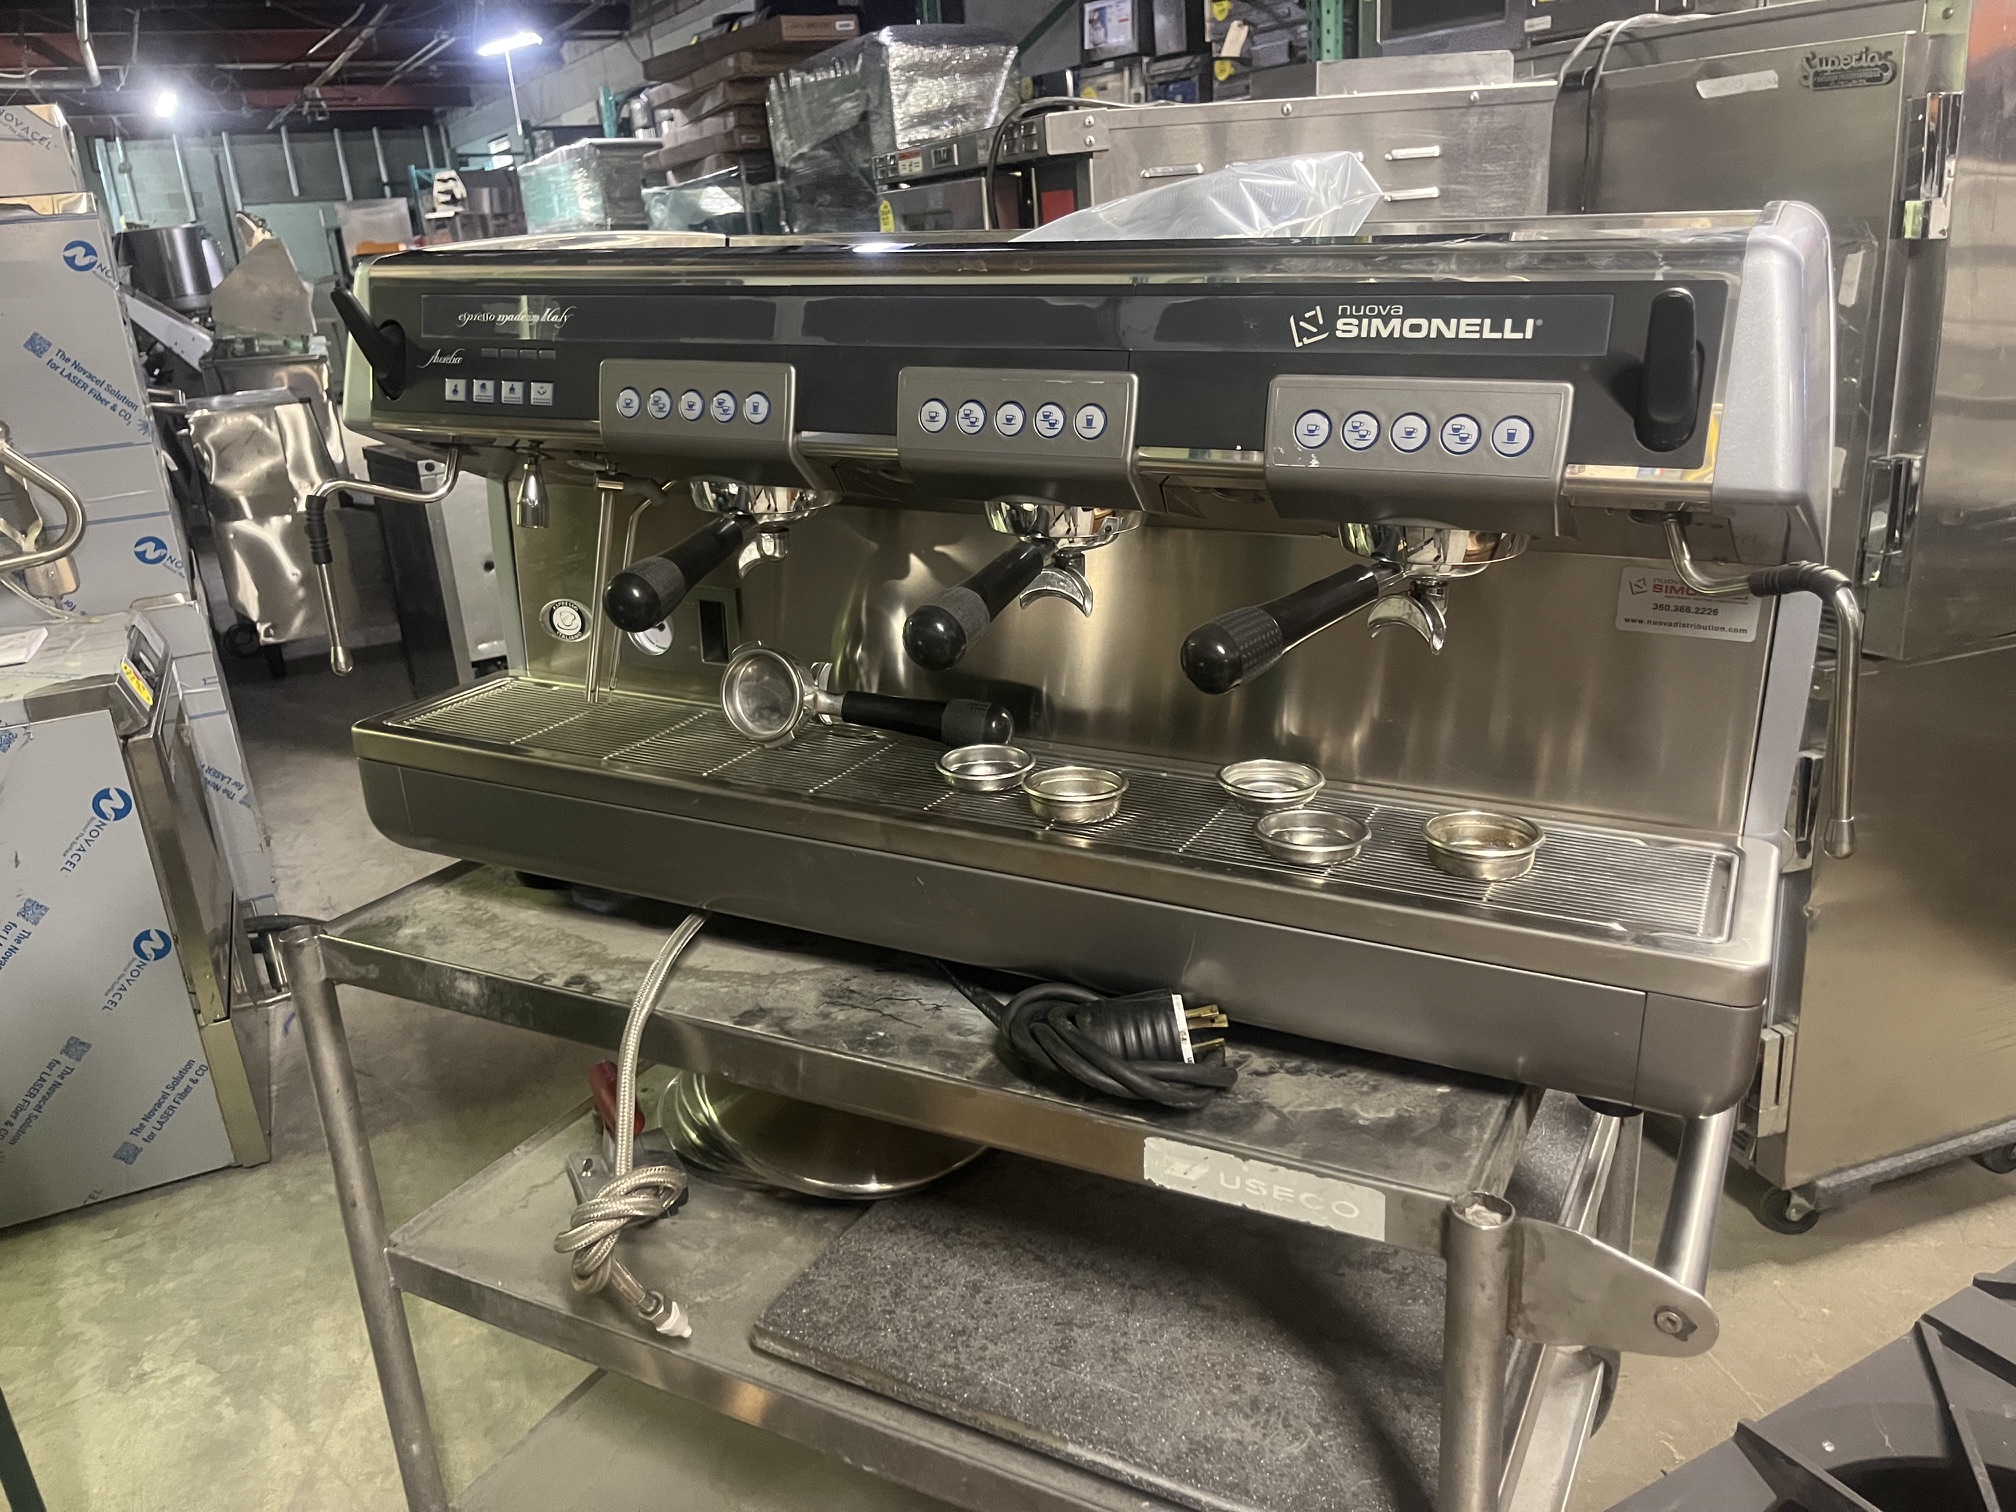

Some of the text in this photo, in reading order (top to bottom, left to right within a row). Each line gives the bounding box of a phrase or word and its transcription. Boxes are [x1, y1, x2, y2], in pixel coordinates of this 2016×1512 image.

[456, 312, 495, 328] espresso
[495, 308, 529, 326] made
[539, 306, 577, 328] Italy
[1338, 305, 1403, 315] nuova
[1335, 318, 1534, 339] SIMONELLI
[417, 348, 465, 368] Aurelia
[46, 358, 60, 371] for
[59, 368, 89, 392] LASER
[88, 387, 111, 407] Fiber
[110, 403, 118, 412] &
[55, 348, 139, 412] The Novacel Solution
[1624, 617, 1748, 634] www.nuovadistribution.com
[60, 820, 107, 872] NOVACEL
[2, 921, 18, 935] for
[14, 929, 33, 945] The
[102, 960, 147, 1011] NOVACEL
[46, 1058, 61, 1072] for
[25, 1071, 52, 1099] LASER
[9, 1066, 75, 1146] The Novacel Solution
[10, 1098, 31, 1121] Fiber
[129, 1059, 196, 1137] The Novacel Solution
[141, 1131, 157, 1144] for
[152, 1104, 178, 1131] LASER
[172, 1084, 193, 1105] Fiber
[188, 1077, 199, 1085] &
[4, 1120, 15, 1128] &
[1219, 1171, 1361, 1219] USECO
